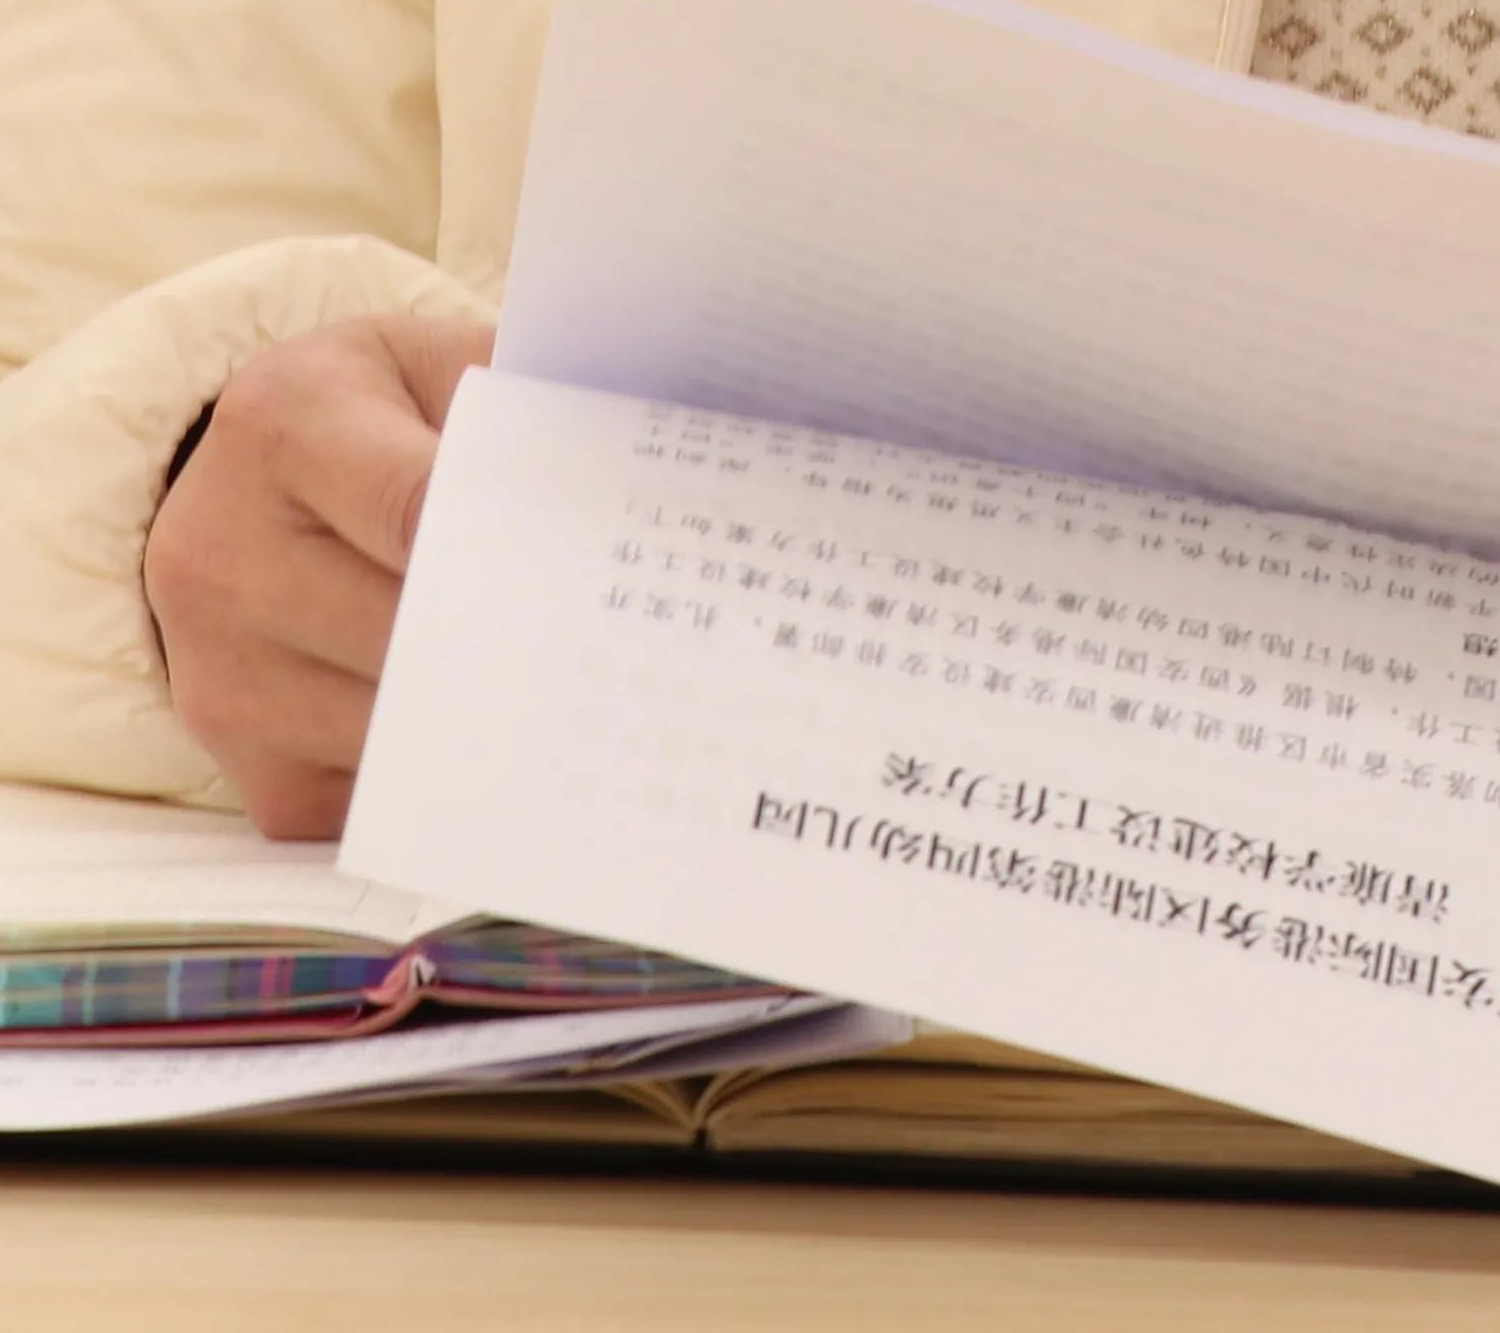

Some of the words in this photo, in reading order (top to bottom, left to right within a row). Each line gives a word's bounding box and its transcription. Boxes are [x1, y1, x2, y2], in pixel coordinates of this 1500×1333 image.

[880, 752, 1449, 924] 清廉学校建设工作方案
